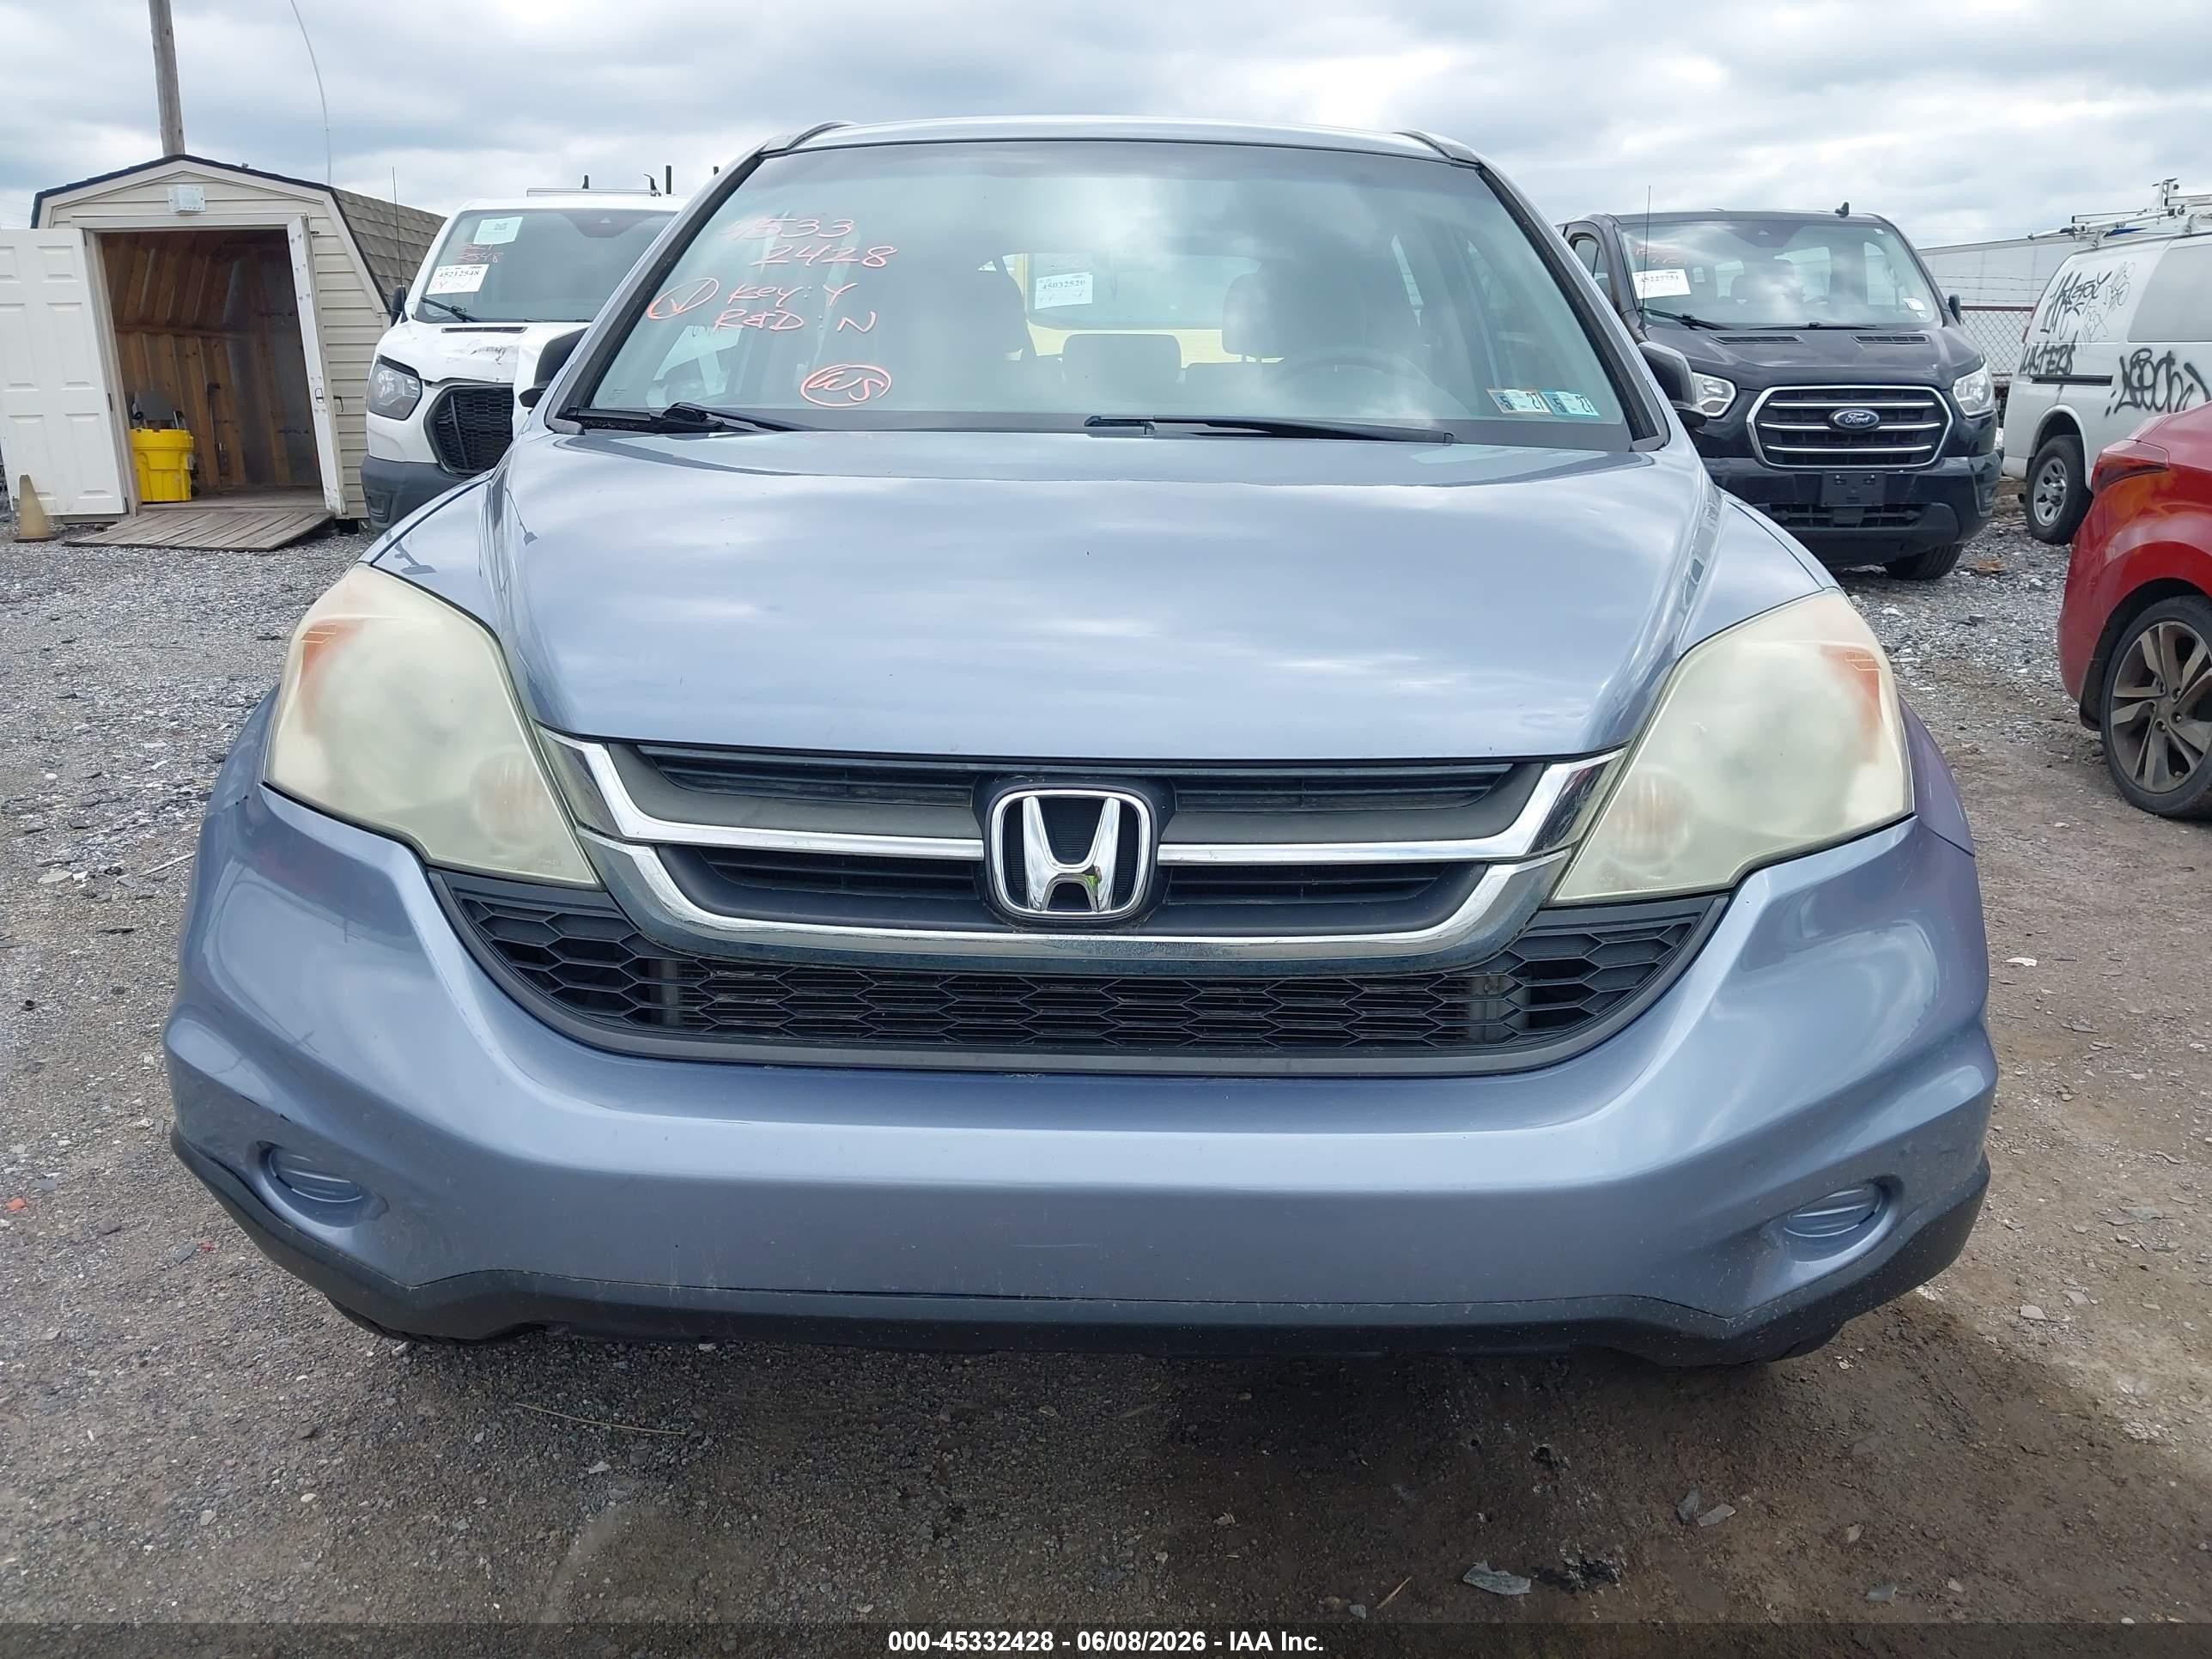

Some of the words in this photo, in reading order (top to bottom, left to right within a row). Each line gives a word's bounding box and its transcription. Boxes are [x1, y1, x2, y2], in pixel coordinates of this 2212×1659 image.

[749, 245, 898, 269] 2428
[837, 311, 877, 333] N
[1844, 412, 1871, 424] Ford
